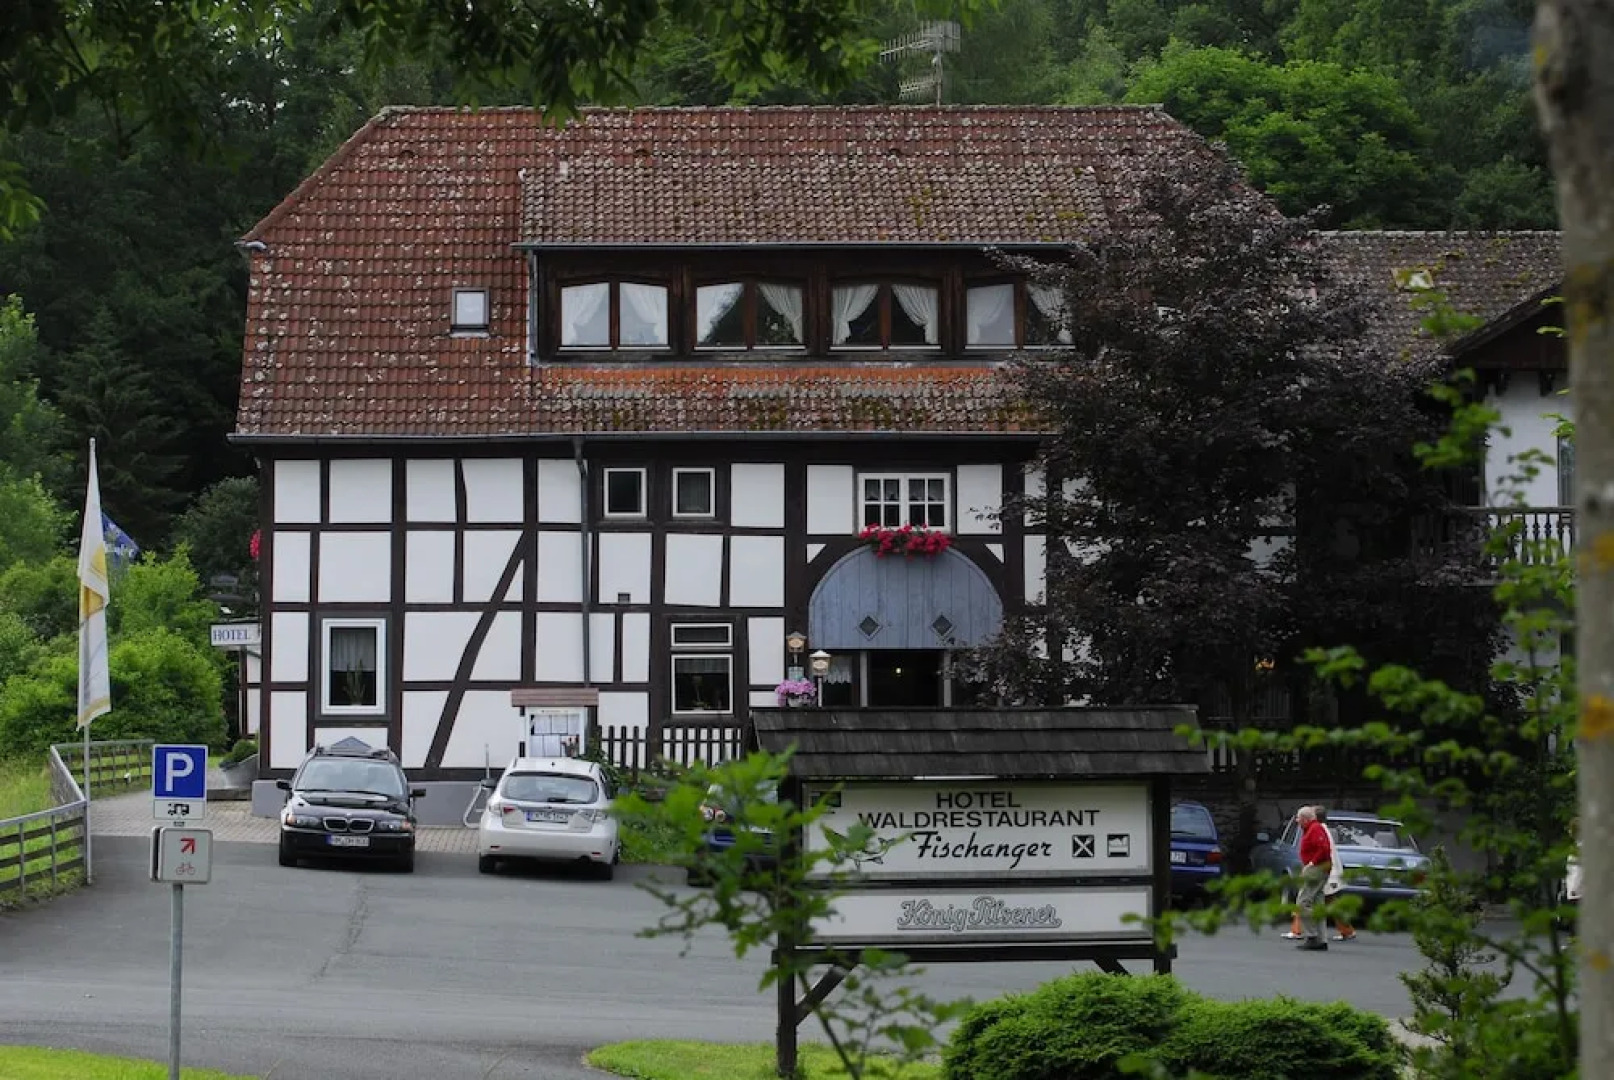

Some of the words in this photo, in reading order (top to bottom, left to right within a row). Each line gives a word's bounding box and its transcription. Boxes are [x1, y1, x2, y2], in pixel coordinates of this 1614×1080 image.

[213, 629, 250, 641] HOTEL
[165, 752, 195, 792] P
[937, 791, 1021, 808] HOTEL
[859, 810, 1100, 828] WALDRESTAURANT
[911, 831, 1052, 869] Fischanger
